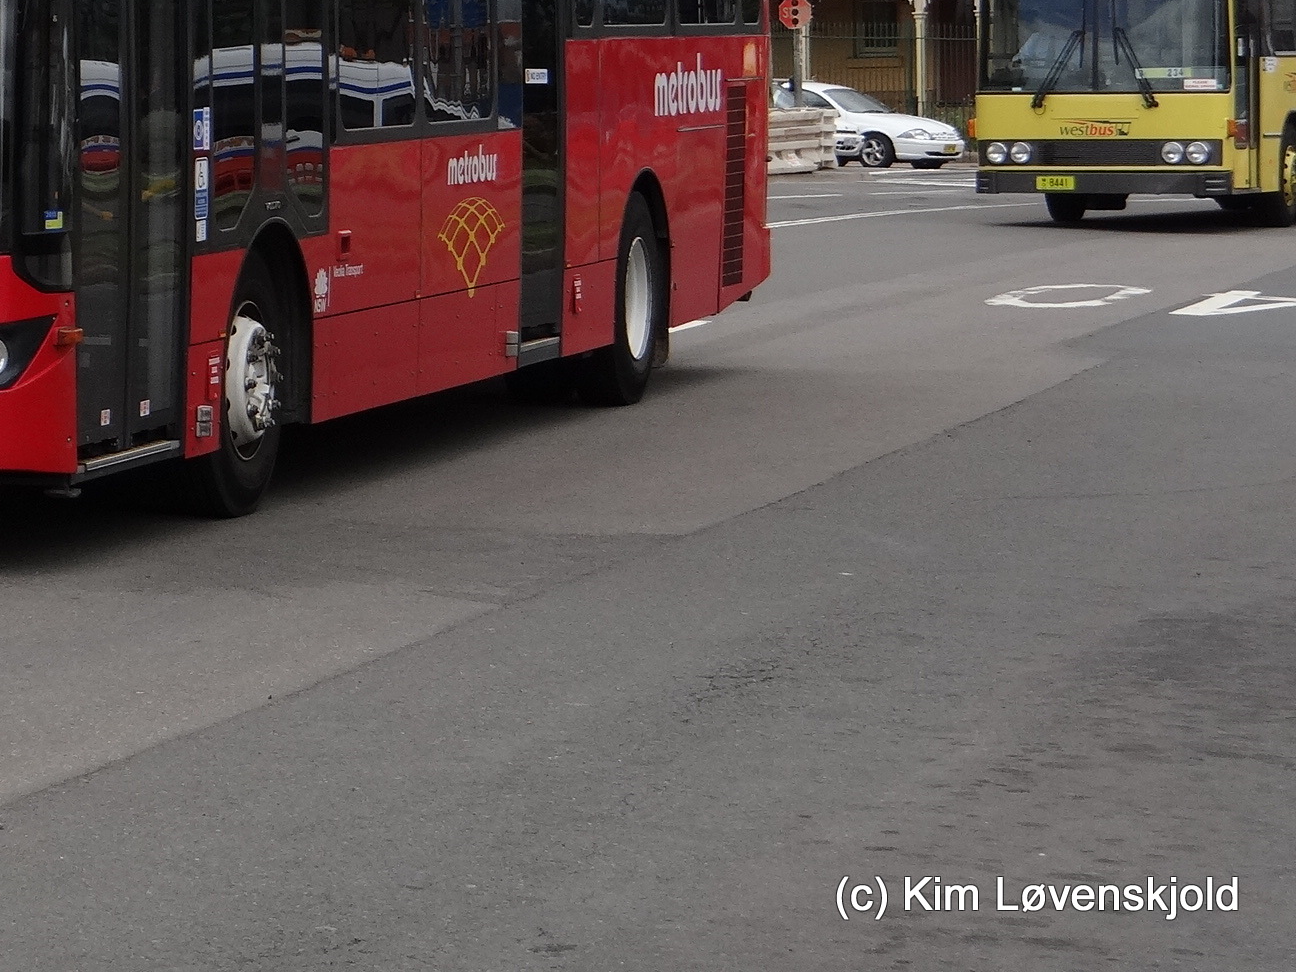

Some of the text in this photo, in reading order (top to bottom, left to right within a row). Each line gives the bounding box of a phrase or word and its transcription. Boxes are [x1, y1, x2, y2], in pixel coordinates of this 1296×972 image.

[654, 53, 721, 117] metrobus
[1059, 124, 1115, 136] westbus
[447, 144, 497, 186] metrobus
